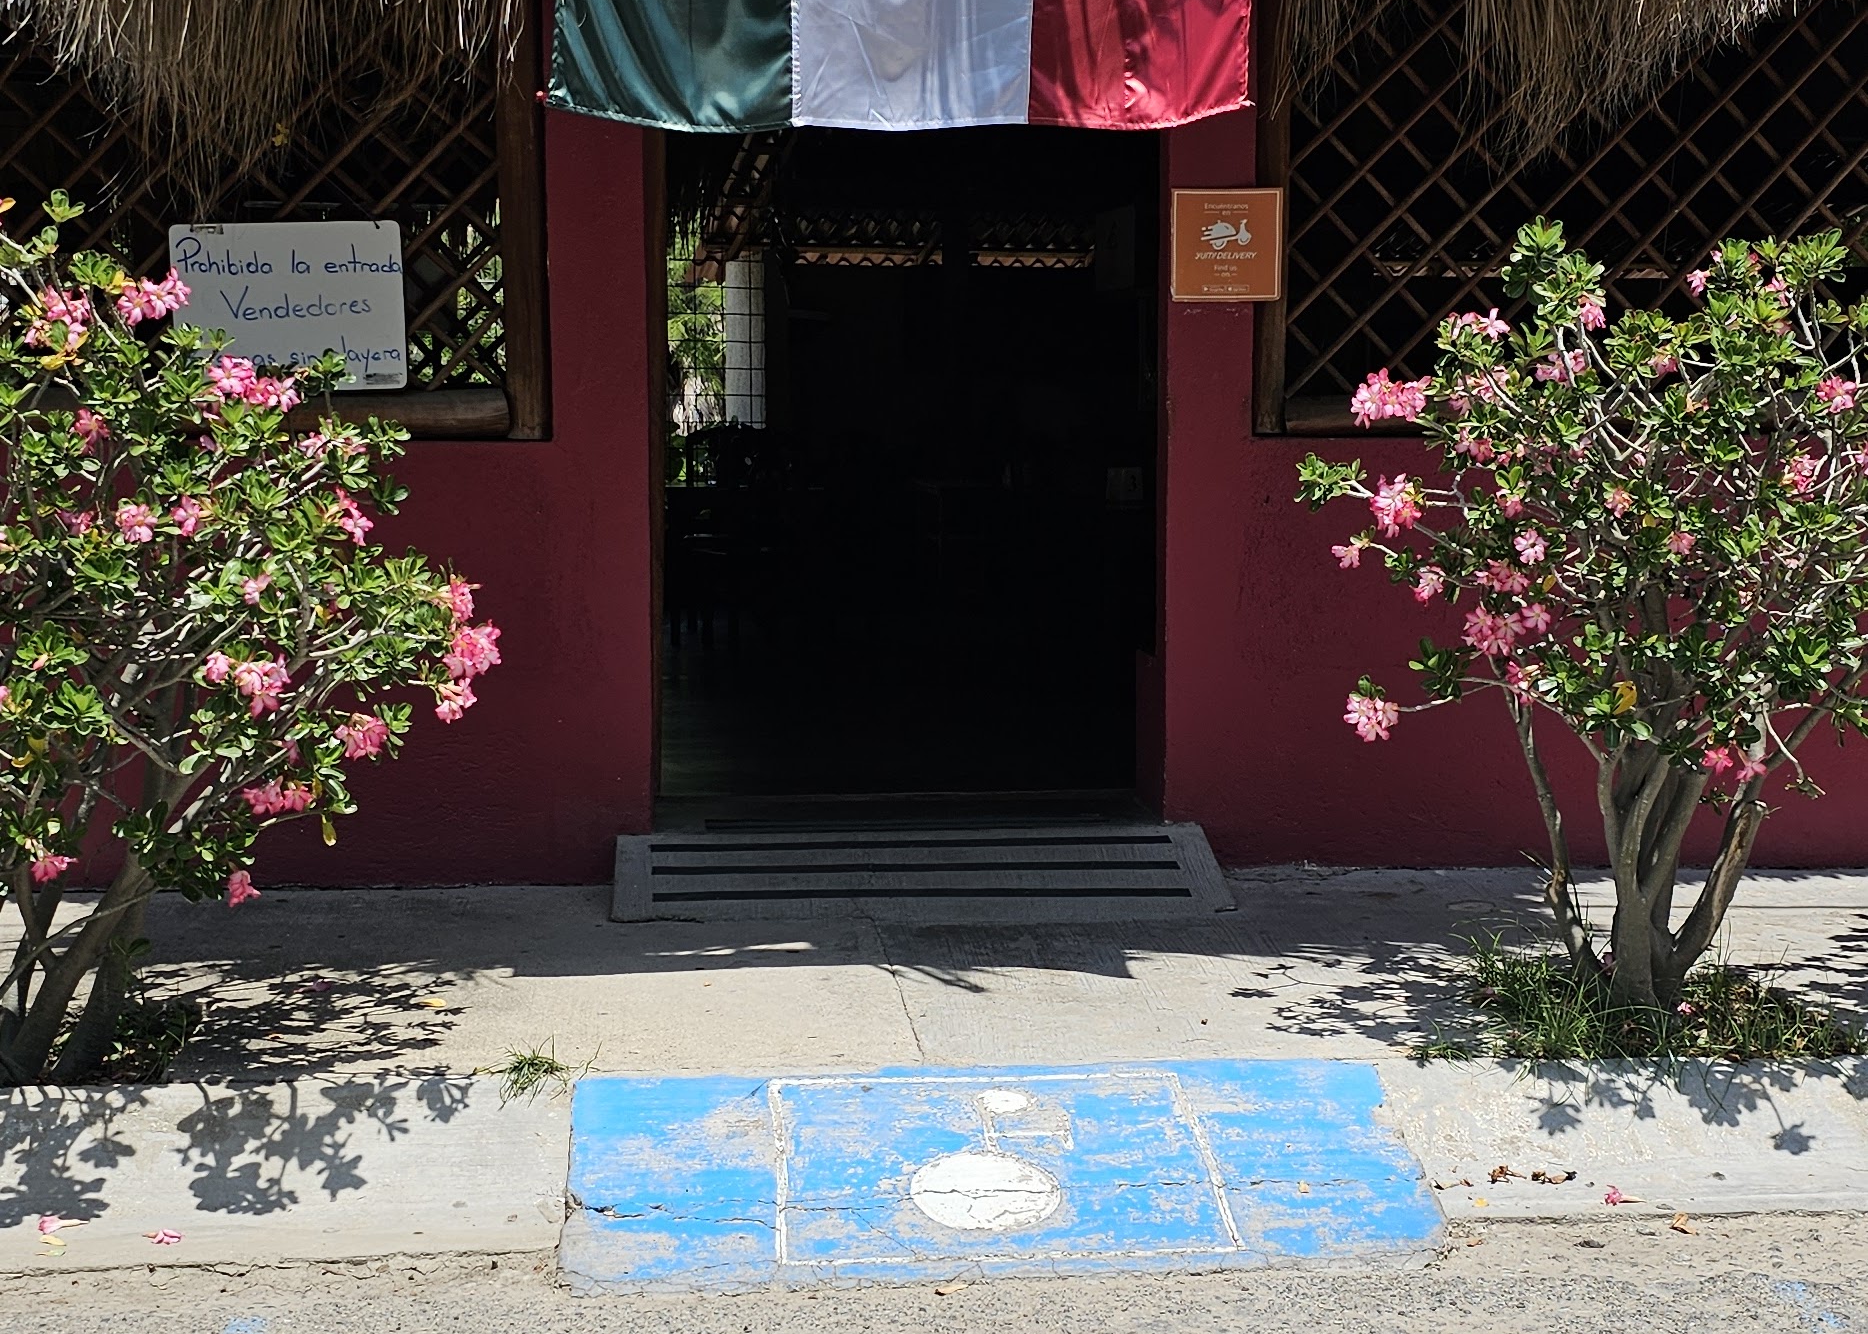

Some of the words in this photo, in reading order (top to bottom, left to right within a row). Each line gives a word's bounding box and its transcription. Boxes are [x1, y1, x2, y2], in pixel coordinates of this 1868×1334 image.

[175, 236, 273, 276] Prohibida
[291, 249, 310, 274] la
[324, 243, 403, 274] entrada
[1217, 251, 1257, 260] DELIVERY
[219, 285, 372, 321] Vendedores
[326, 335, 401, 373] layera
